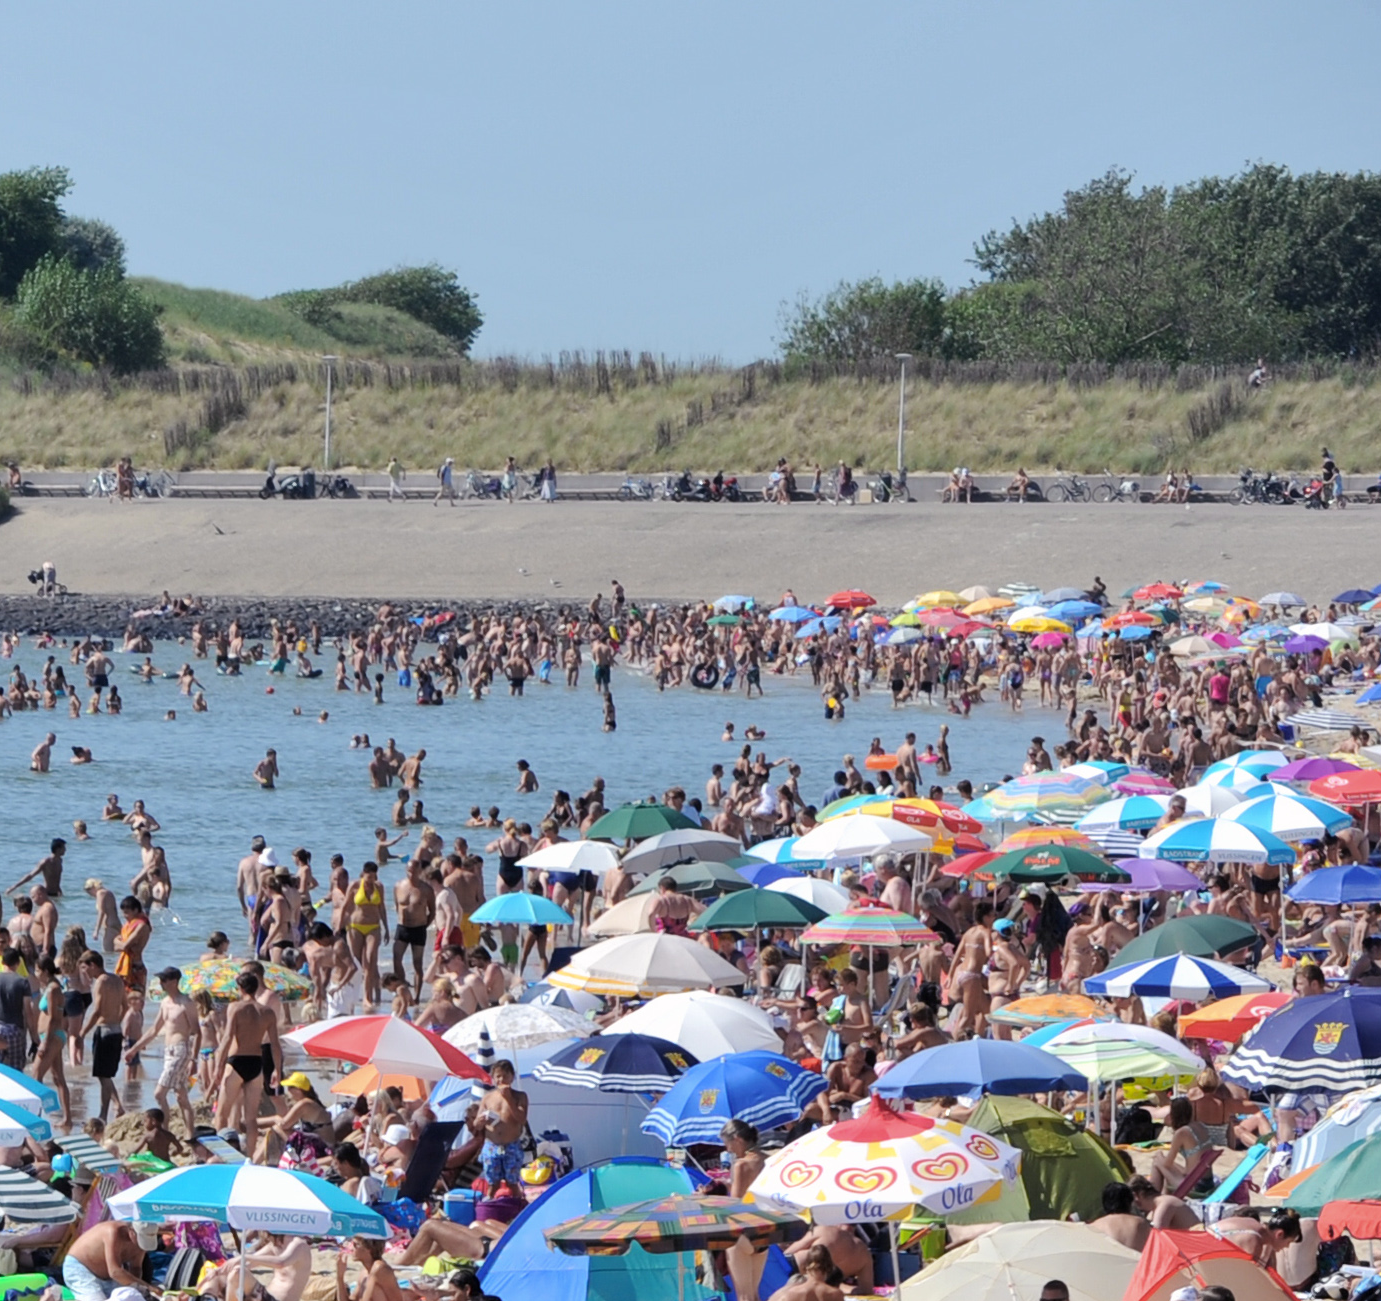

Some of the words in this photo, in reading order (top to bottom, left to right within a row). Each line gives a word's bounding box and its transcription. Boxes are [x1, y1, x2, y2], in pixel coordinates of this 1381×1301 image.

[941, 1183, 974, 1210] Ola
[245, 1211, 317, 1225] VLISSINGEN
[844, 1201, 886, 1220] Ola
